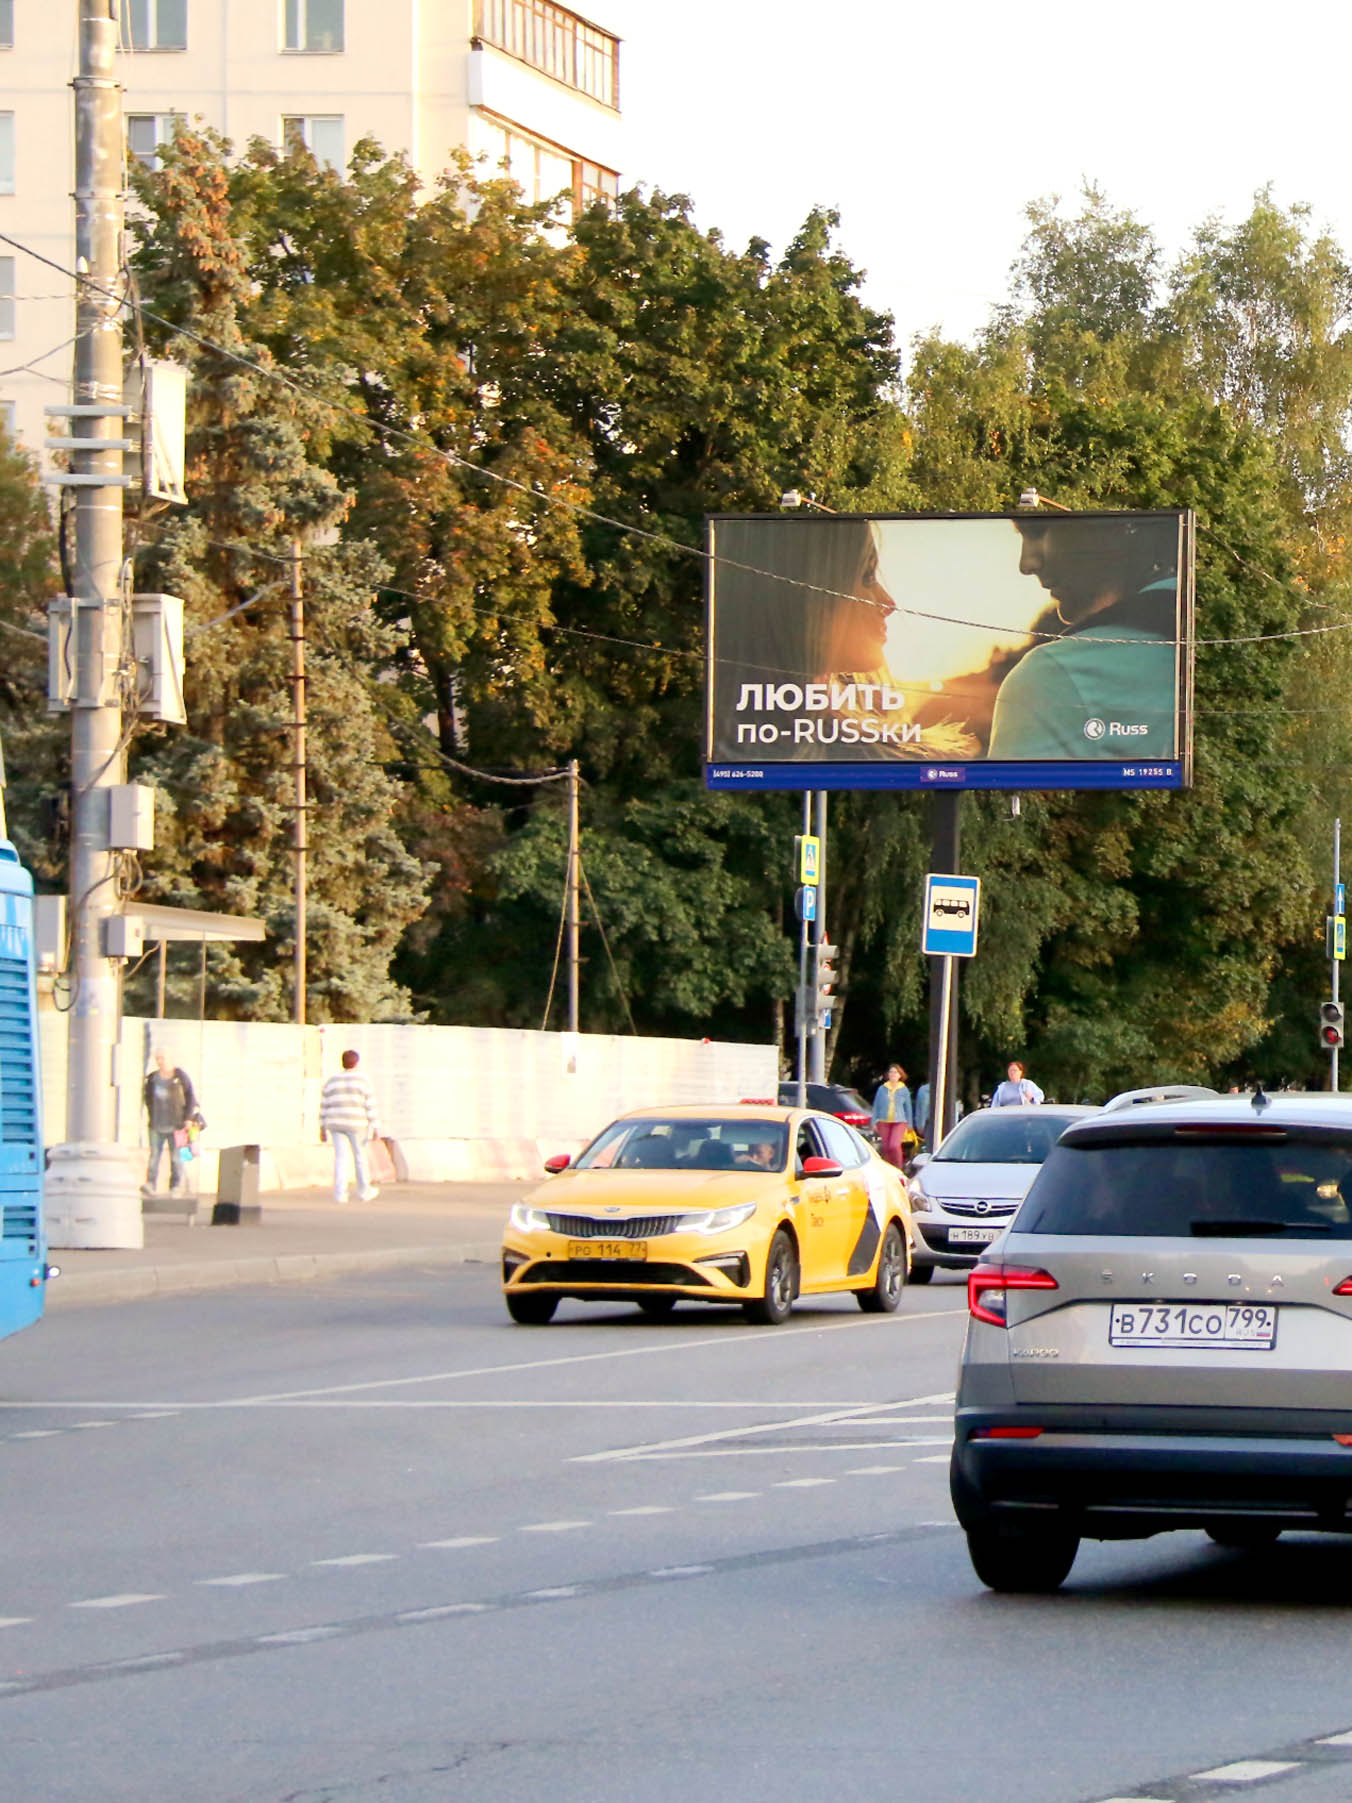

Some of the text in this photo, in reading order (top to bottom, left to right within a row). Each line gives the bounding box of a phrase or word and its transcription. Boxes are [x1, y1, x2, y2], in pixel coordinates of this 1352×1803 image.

[736, 683, 905, 711] ЛЮБИТЬ
[737, 718, 921, 744] по-RUSSки
[1109, 721, 1149, 736] Russ
[1228, 1307, 1267, 1329] 799
